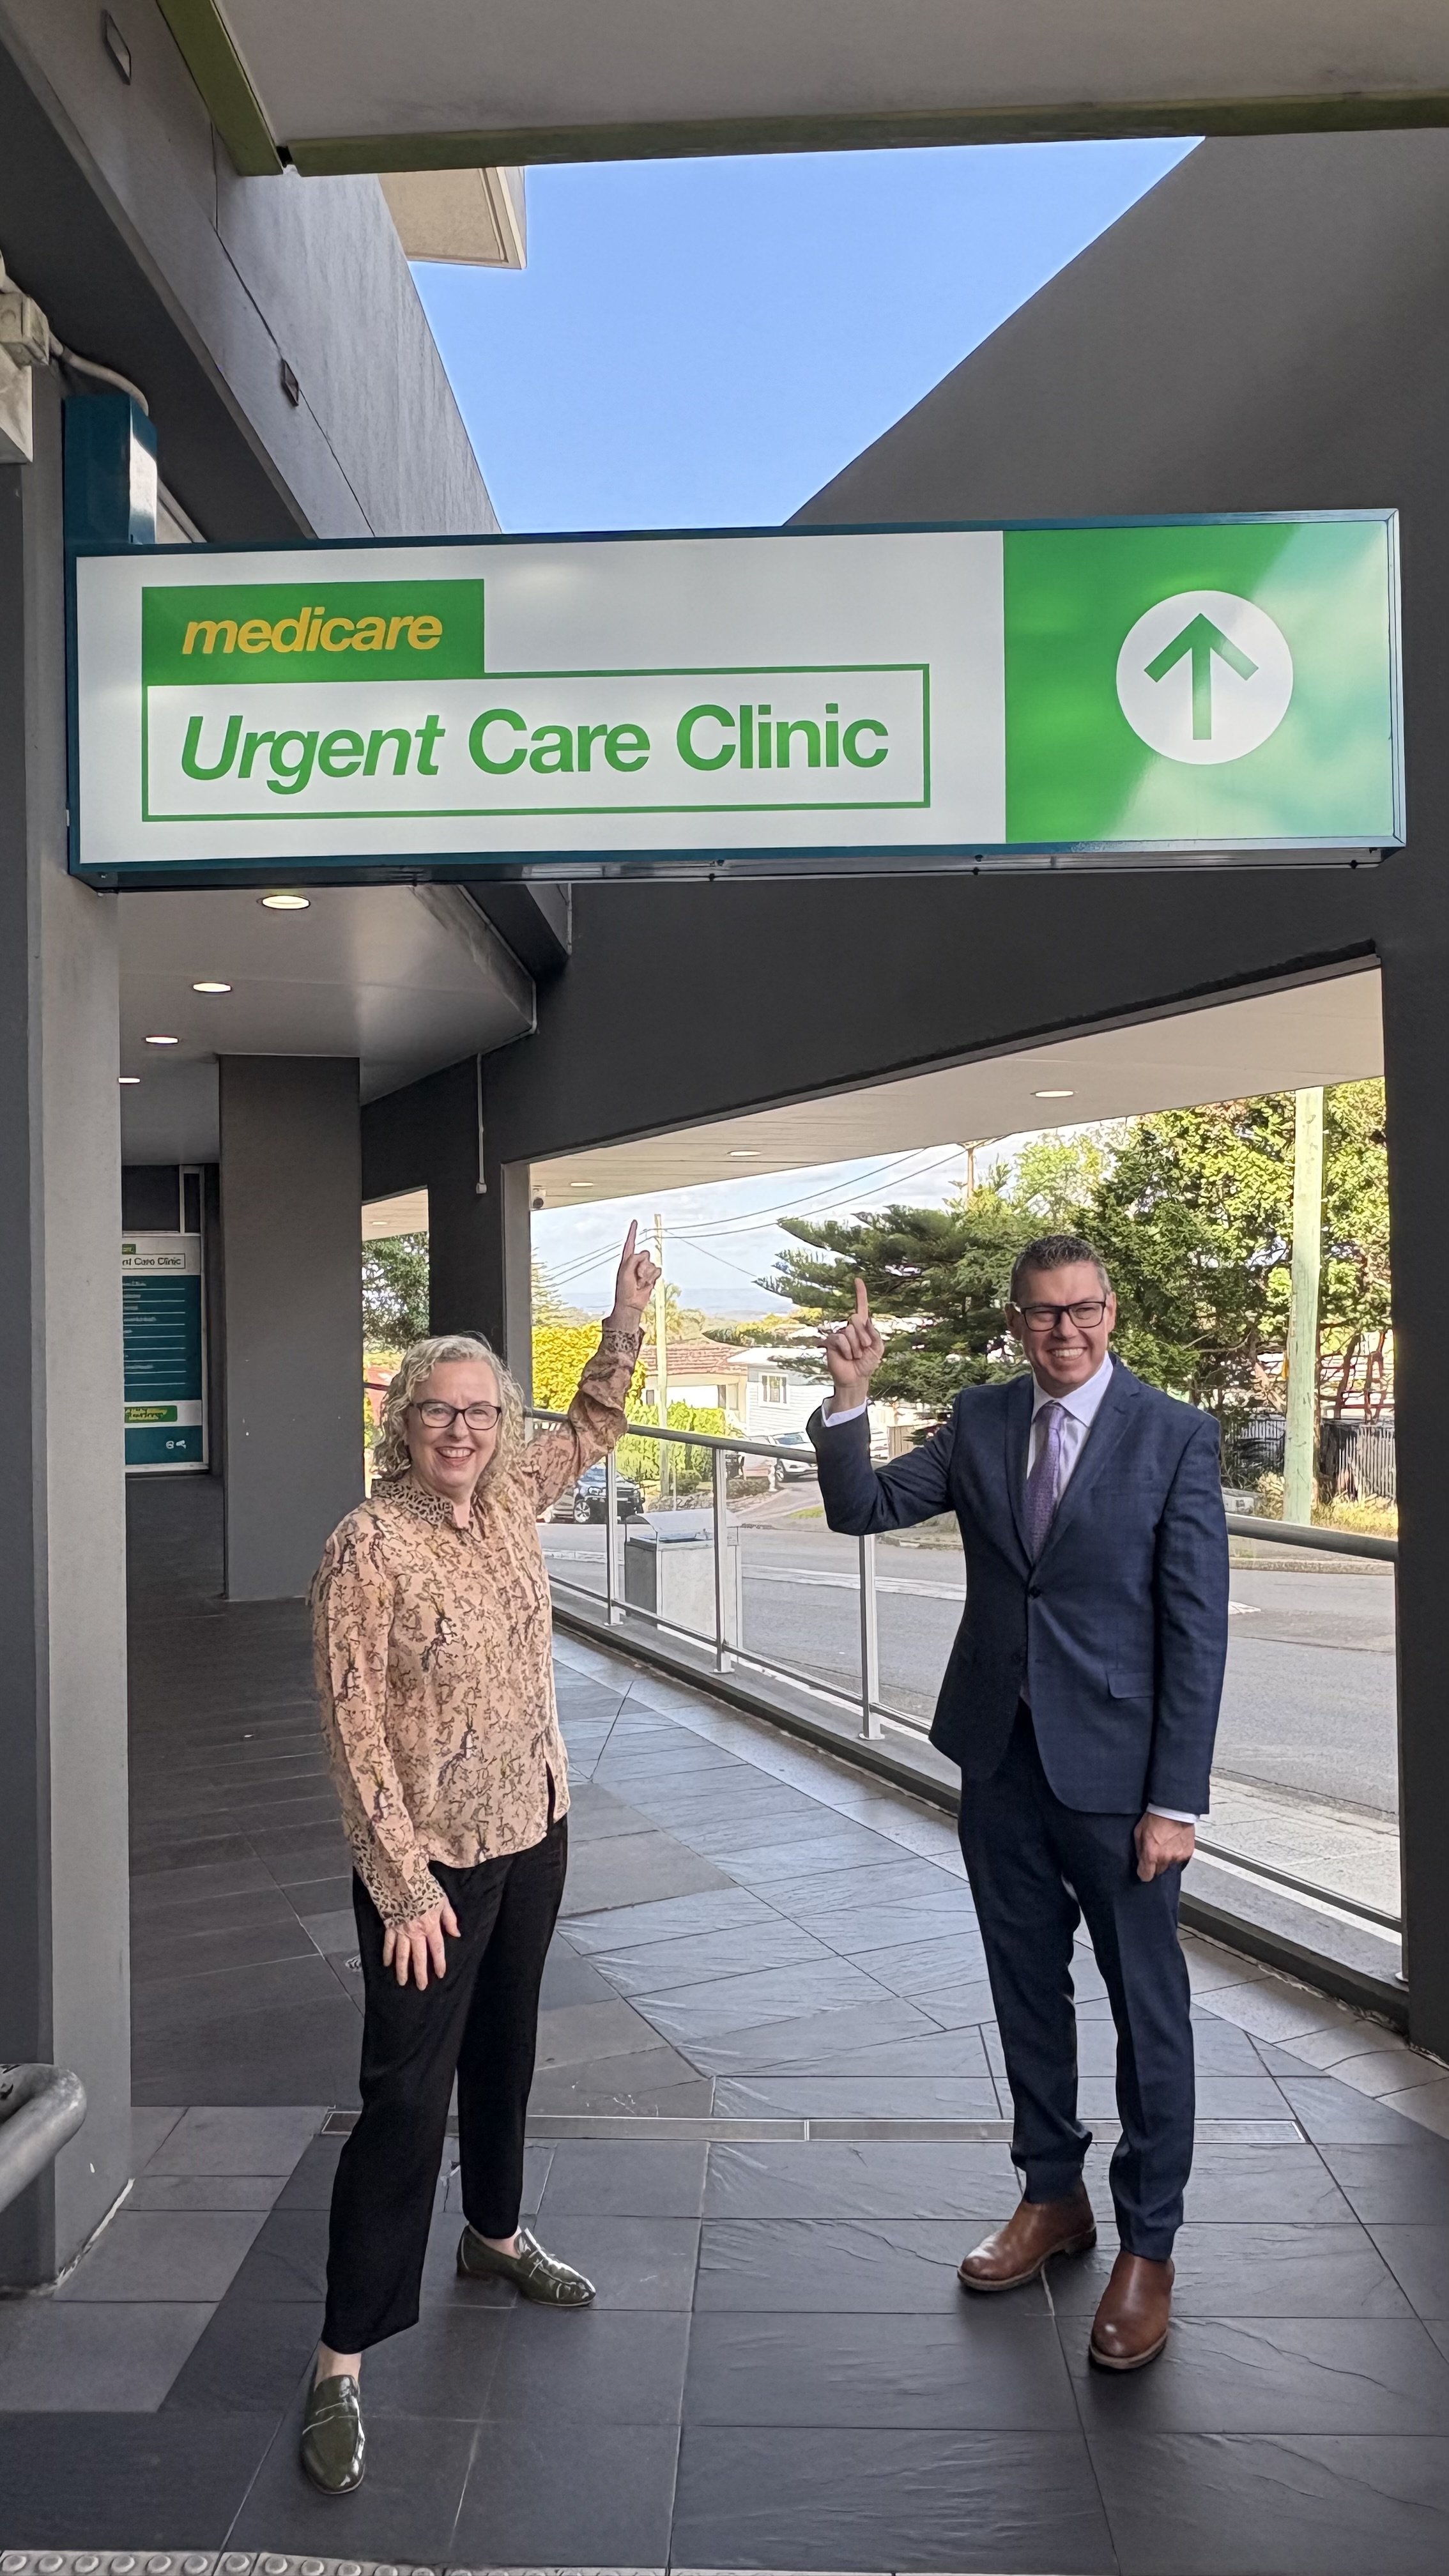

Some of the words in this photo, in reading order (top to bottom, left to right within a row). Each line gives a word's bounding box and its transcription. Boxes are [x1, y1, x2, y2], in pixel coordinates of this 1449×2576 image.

[183, 607, 443, 654] medicare
[182, 716, 445, 795] Urgent
[468, 709, 650, 774] Care
[677, 703, 888, 770] Clinic
